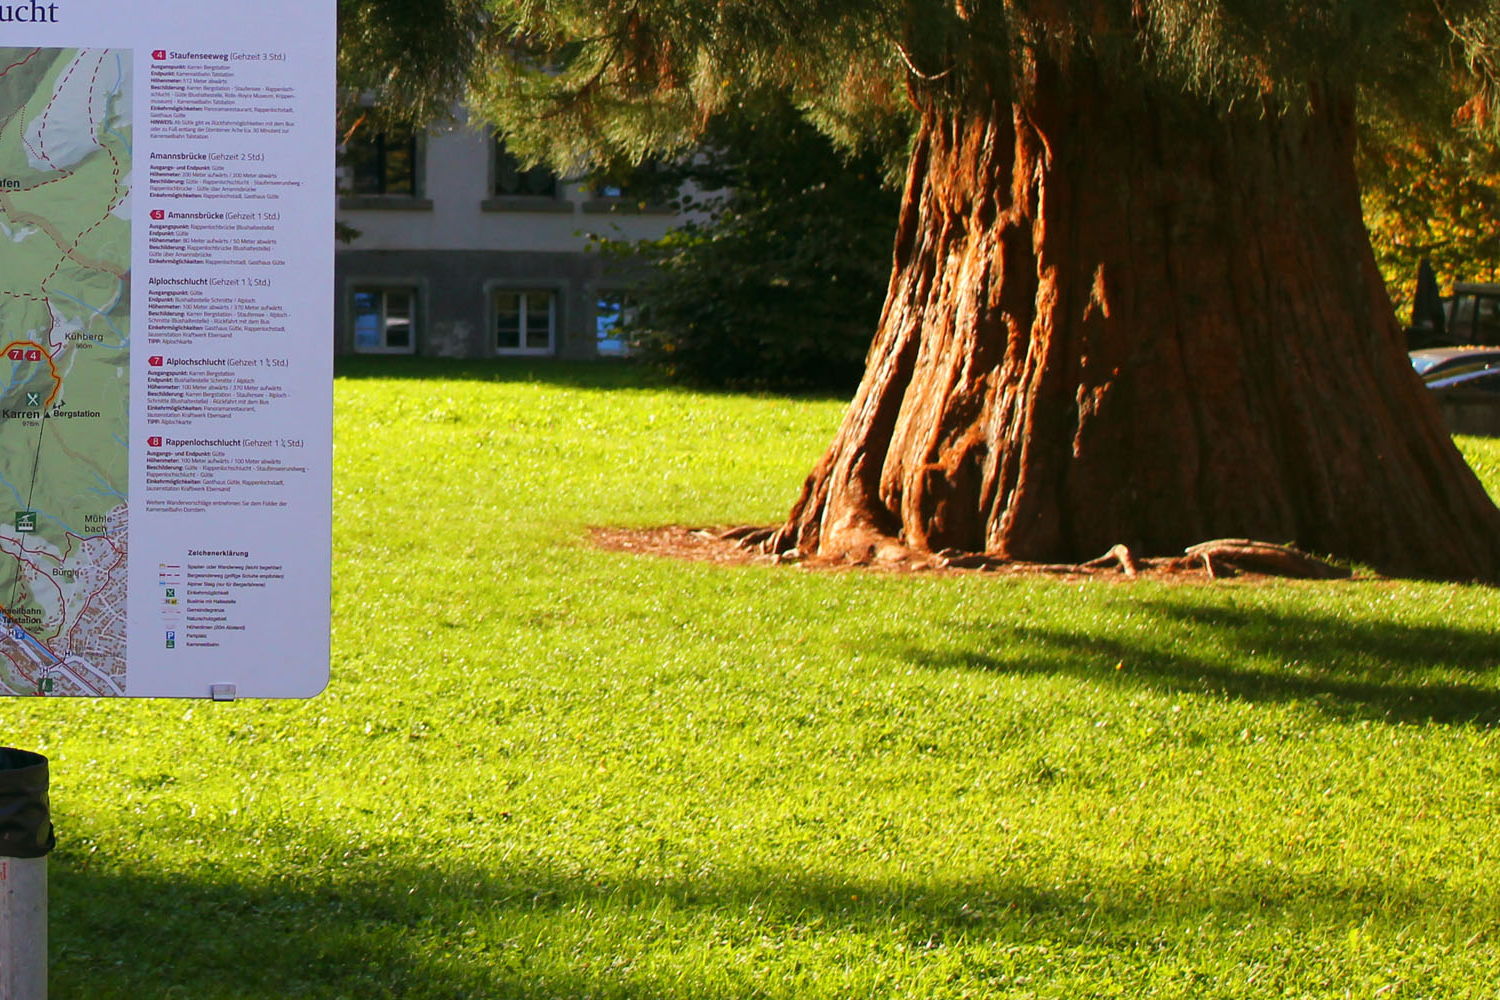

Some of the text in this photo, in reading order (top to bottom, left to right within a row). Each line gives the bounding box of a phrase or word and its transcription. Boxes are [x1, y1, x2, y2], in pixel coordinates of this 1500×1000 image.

[170, 52, 228, 61] Staufenseeweg
[230, 52, 260, 61] (Gehzeit
[270, 52, 286, 61] Std.)
[150, 152, 207, 160] Amannsbrücke
[208, 152, 239, 161] (Gehzeit
[168, 211, 224, 220] Amannsbrücke
[226, 212, 255, 220] (Gehzeit
[264, 212, 280, 220] Std.)
[148, 278, 208, 286] Alplochschlucht
[209, 278, 239, 286] (Gehzeit
[254, 279, 270, 287] Std.)
[65, 332, 104, 342] Kühberg
[12, 350, 20, 359] 7
[166, 358, 226, 366] Alplochschlucht
[227, 358, 257, 367] (Gehzeit
[272, 359, 288, 367] Std.)
[2, 409, 40, 418] Karren
[53, 410, 100, 418] Bergstation
[166, 438, 240, 448] Rappenlochschlucht
[242, 439, 272, 448] (Gehzeit
[288, 440, 304, 448] Std.)
[84, 514, 115, 523] Mühle-
[188, 550, 249, 558] Zeichenerklärung
